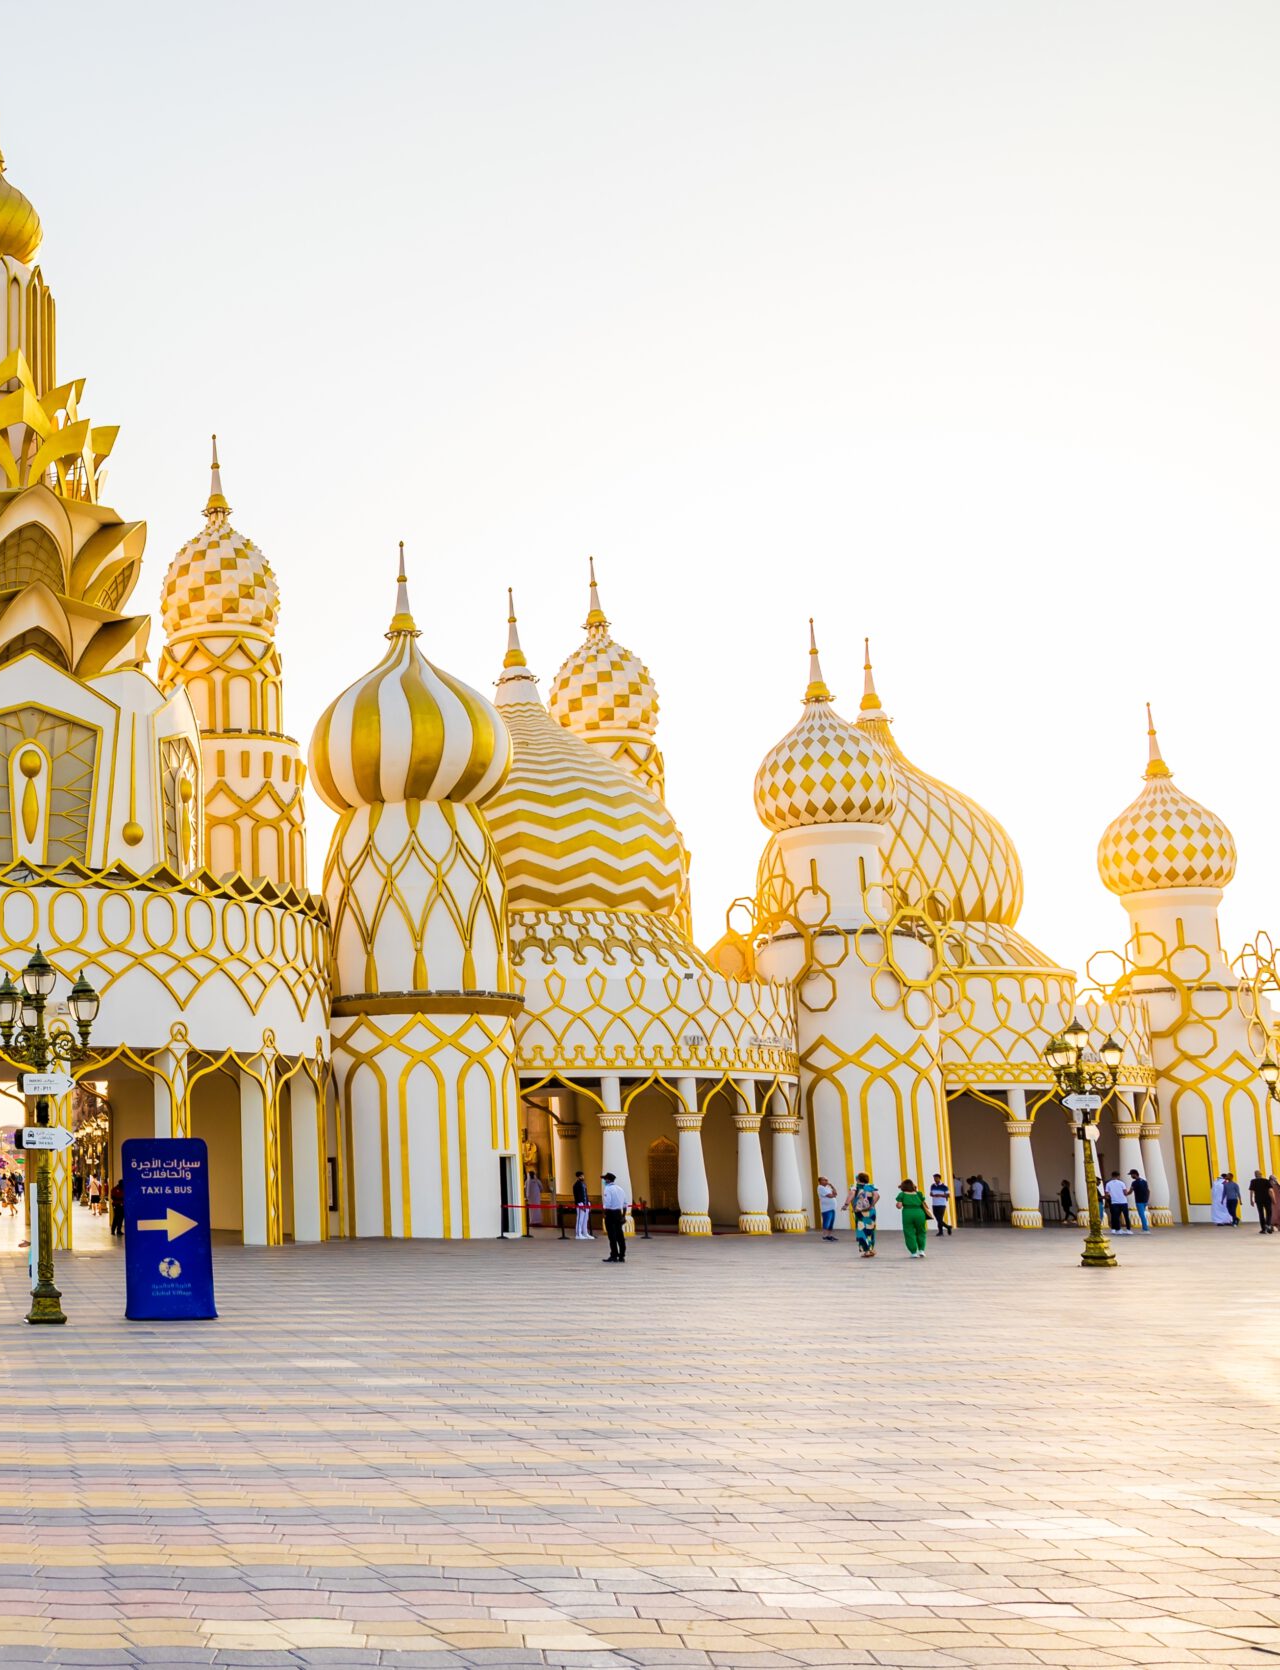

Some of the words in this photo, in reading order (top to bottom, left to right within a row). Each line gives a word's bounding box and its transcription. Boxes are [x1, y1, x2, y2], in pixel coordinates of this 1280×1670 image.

[683, 1035, 704, 1046] VIP
[131, 1157, 161, 1171] الأجرة
[163, 1159, 201, 1170] سيارات
[141, 1169, 192, 1180] والحافلات
[141, 1186, 163, 1194] TAXI
[164, 1186, 172, 1194] &
[174, 1186, 192, 1194] BUS
